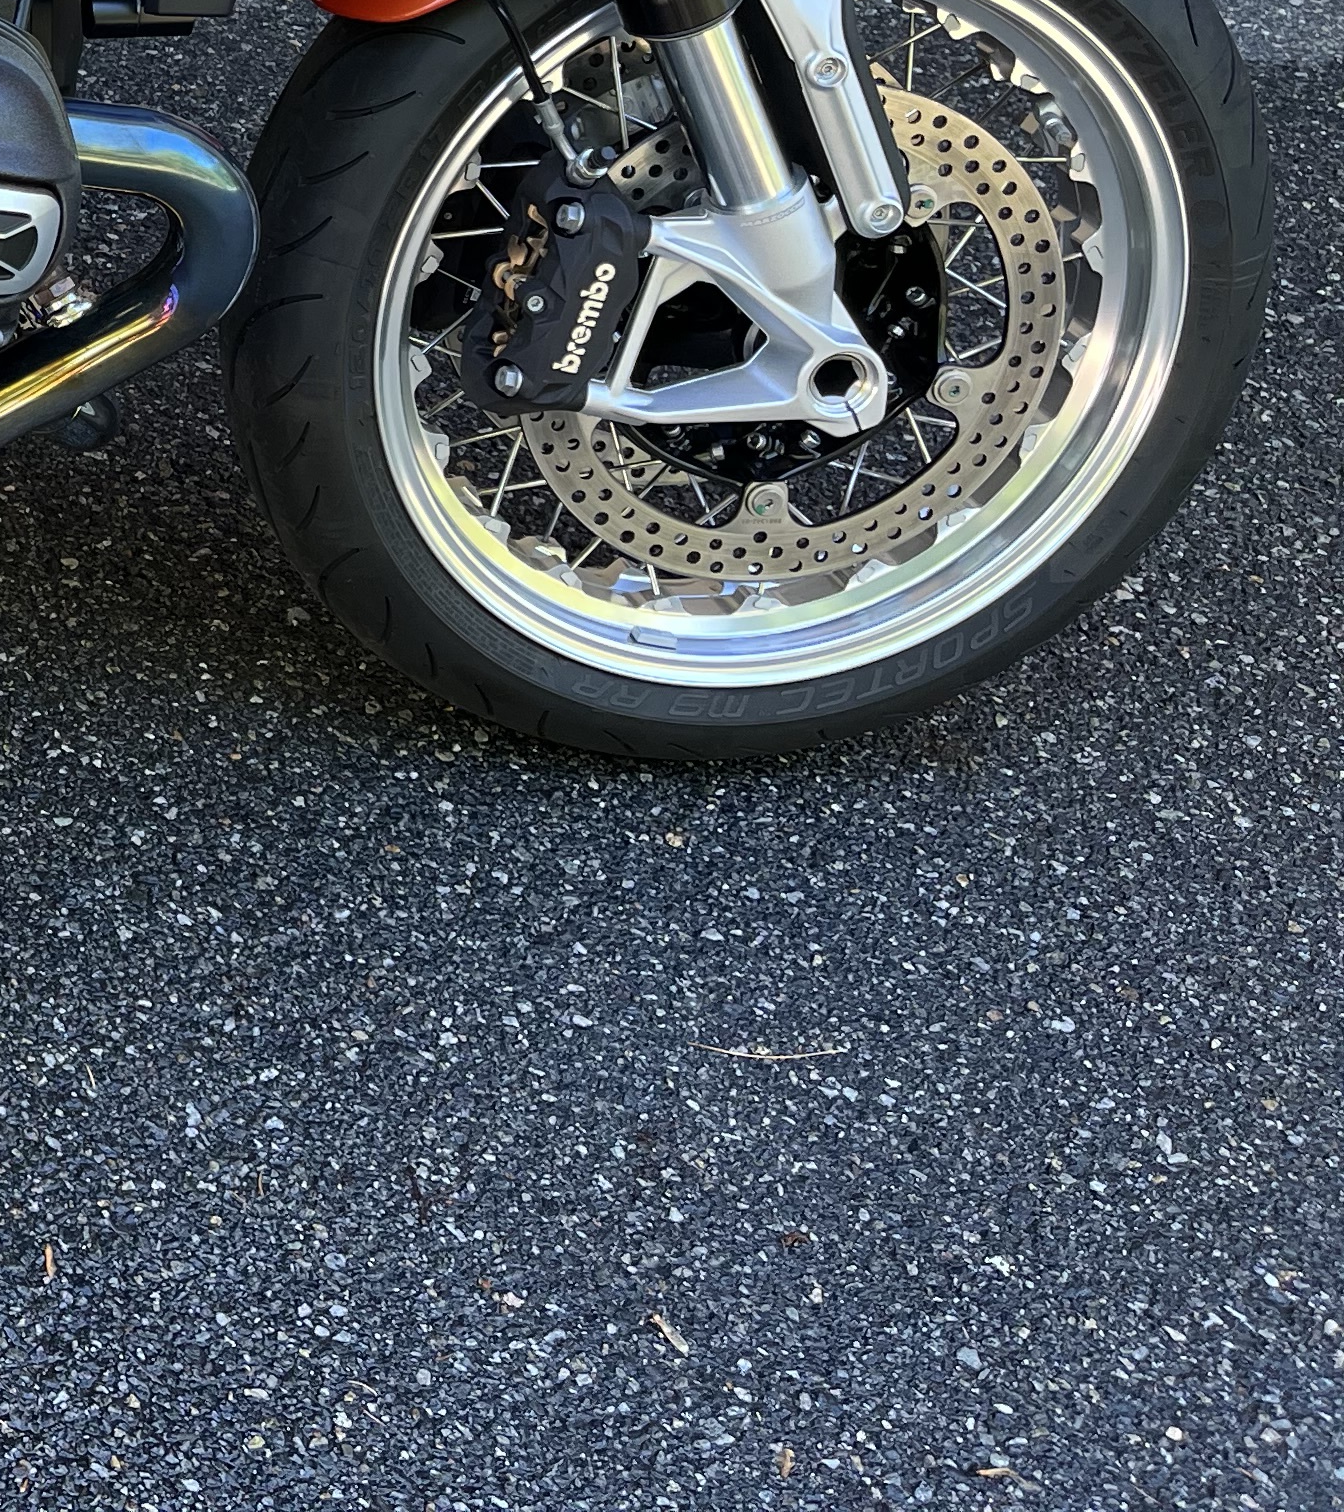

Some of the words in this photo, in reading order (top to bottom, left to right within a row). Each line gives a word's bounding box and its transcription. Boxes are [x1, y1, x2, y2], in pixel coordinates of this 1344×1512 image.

[552, 263, 615, 374] brembo
[569, 671, 651, 709] RR
[775, 580, 1034, 715] SPORTEC
